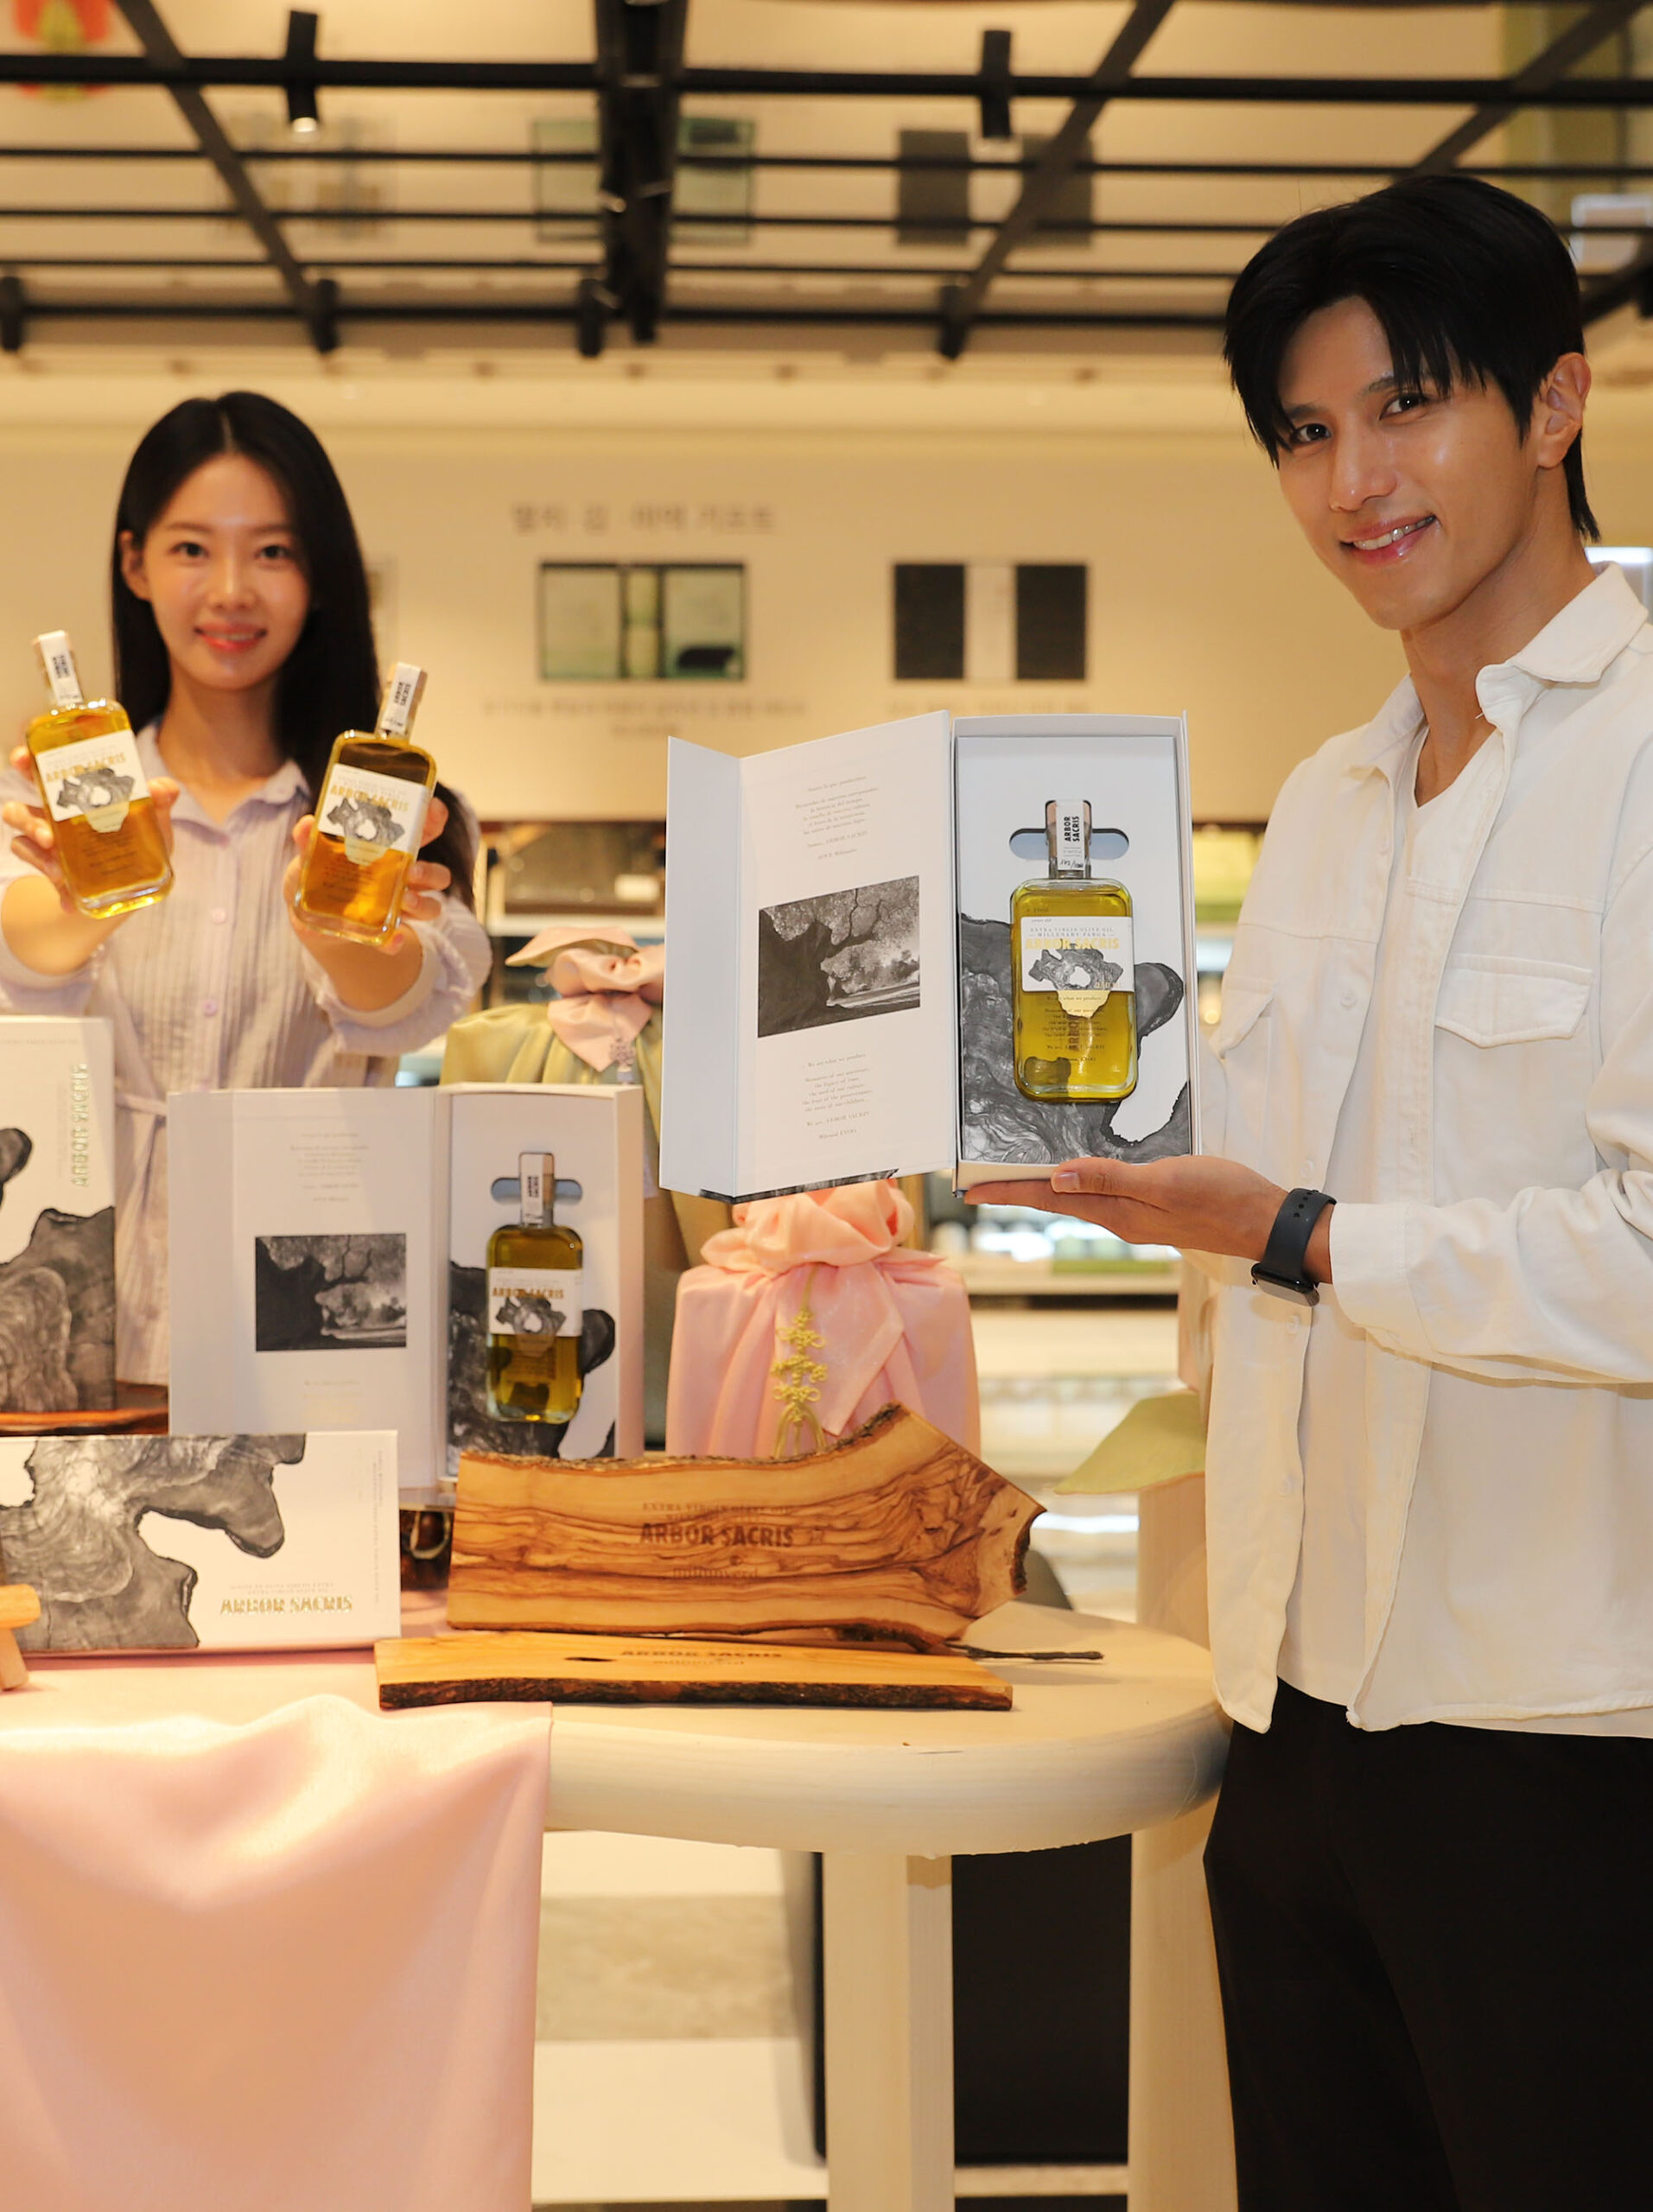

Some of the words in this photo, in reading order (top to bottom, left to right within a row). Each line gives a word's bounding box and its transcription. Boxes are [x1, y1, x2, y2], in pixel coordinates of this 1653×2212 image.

[1026, 938, 1070, 950] ARBOR
[1075, 938, 1120, 950] SACRIS
[640, 1523, 715, 1545] ARBOR
[721, 1525, 793, 1548] SACRIS
[220, 1599, 285, 1614] ARBOR
[290, 1596, 353, 1612] SACRIS
